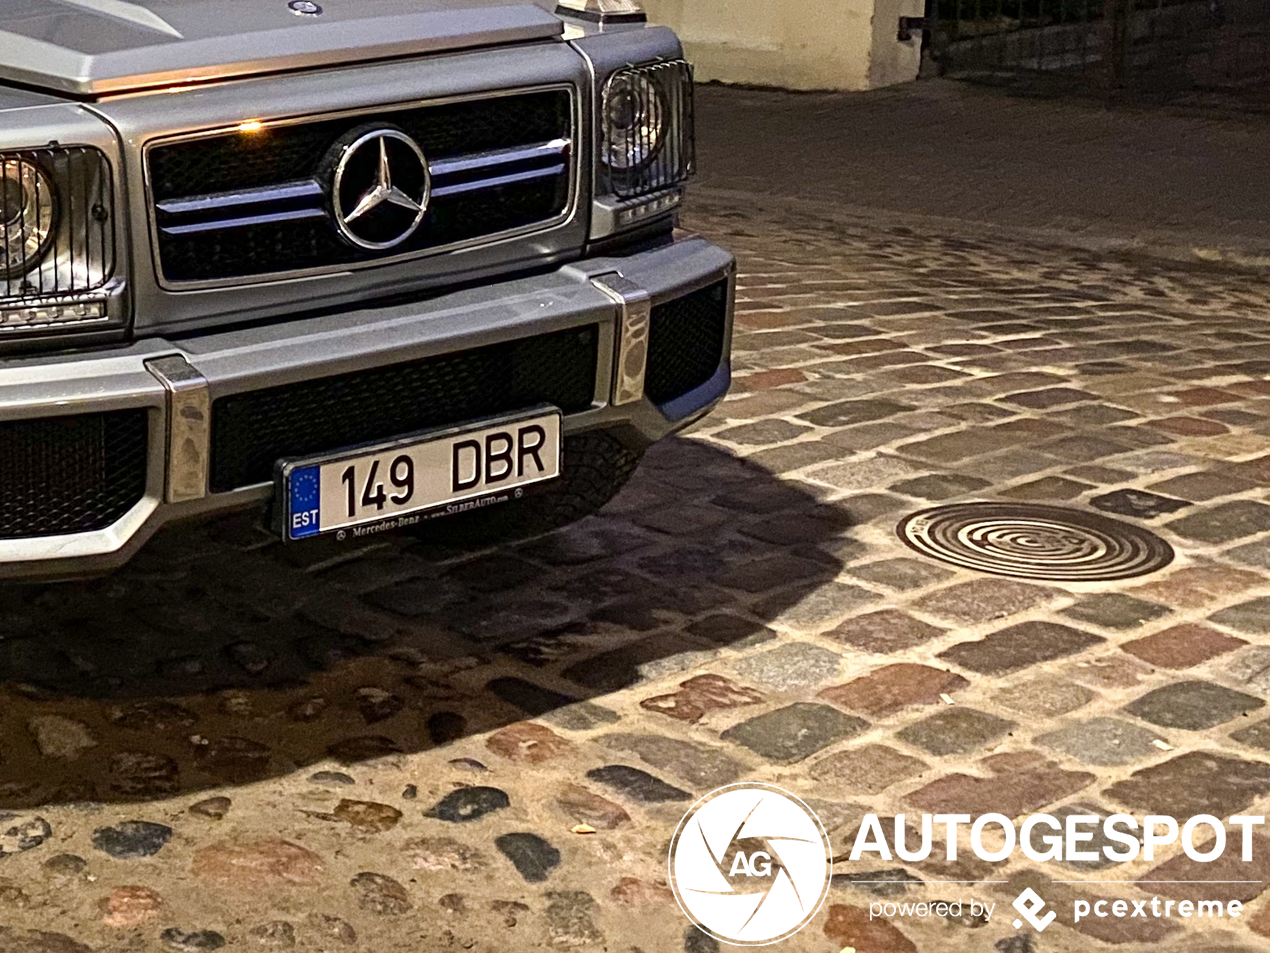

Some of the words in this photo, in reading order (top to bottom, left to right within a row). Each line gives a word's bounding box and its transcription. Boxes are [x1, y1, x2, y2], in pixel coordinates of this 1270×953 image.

[341, 455, 415, 518] 149
[451, 424, 547, 493] DBR
[292, 509, 319, 528] EST
[352, 515, 420, 538] Mercedes-Benz
